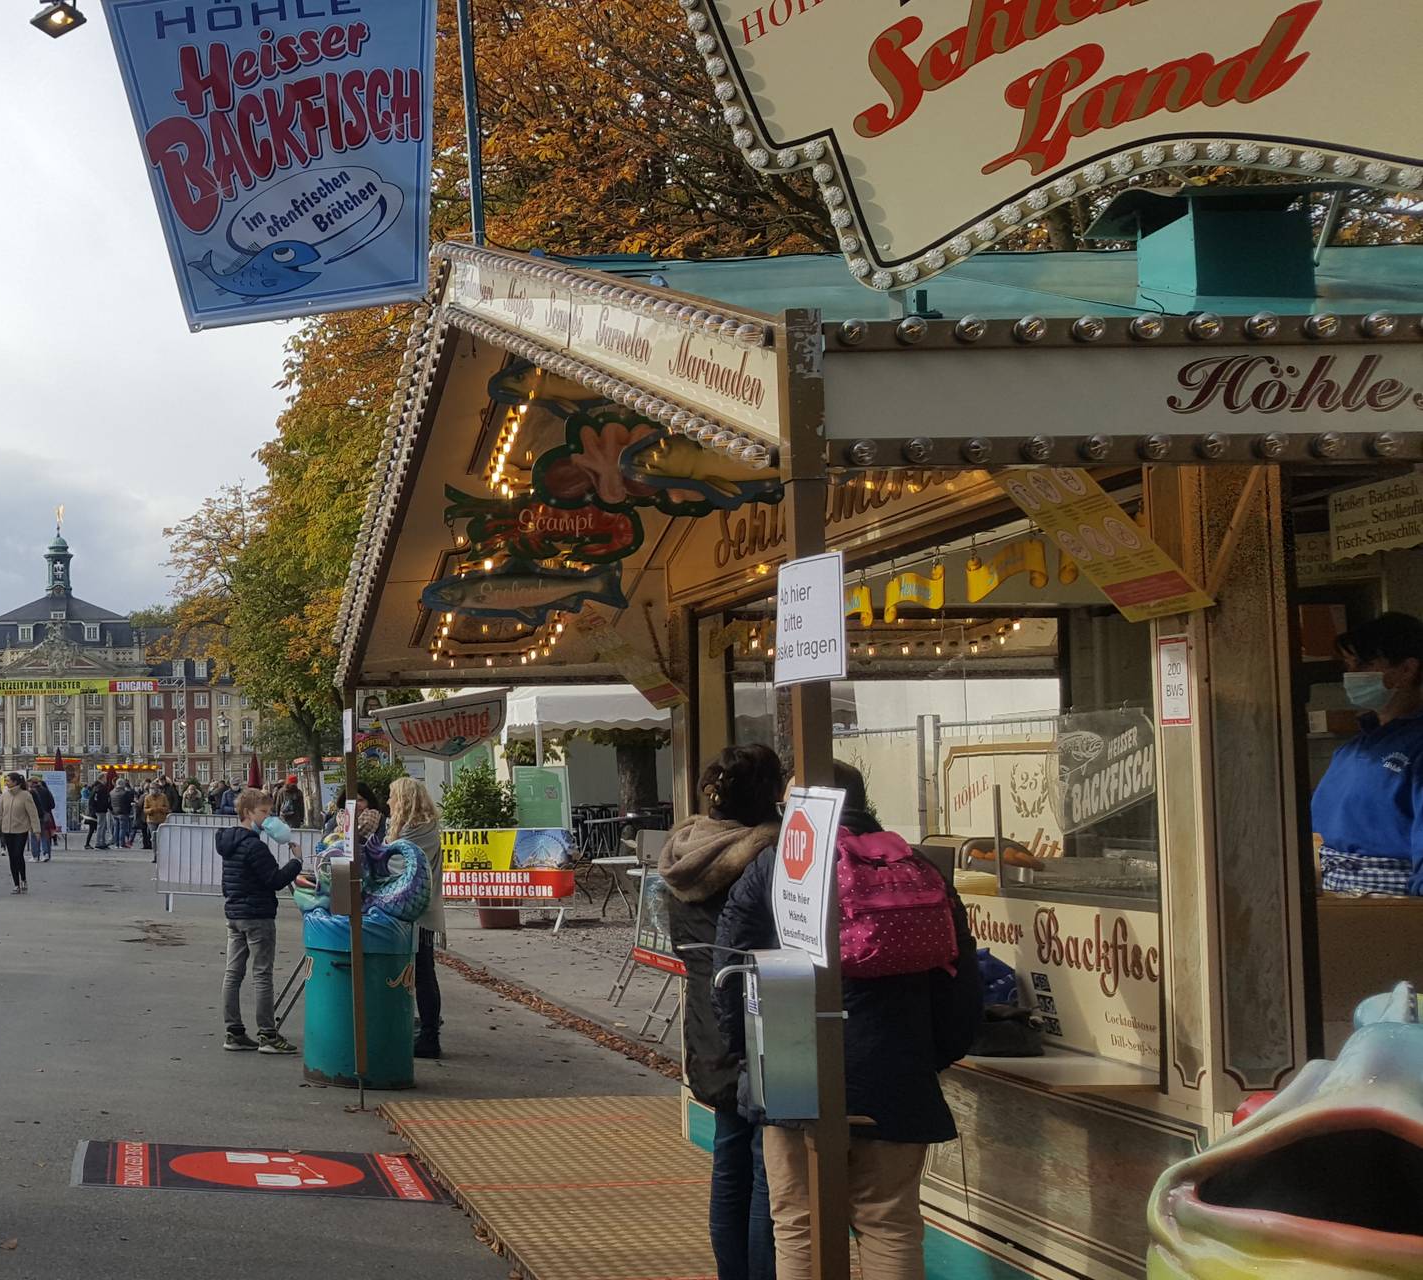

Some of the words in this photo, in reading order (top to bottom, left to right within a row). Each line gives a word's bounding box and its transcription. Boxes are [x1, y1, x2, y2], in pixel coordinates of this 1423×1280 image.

[173, 21, 370, 117] Heisser
[981, 0, 1323, 176] Land
[145, 66, 423, 233] BACKFISCH
[265, 168, 351, 238] ofenfrischen
[312, 180, 378, 234] Brötchen
[241, 211, 268, 233] im
[595, 307, 652, 366] Garnelen
[668, 331, 765, 410] Marinaden
[1166, 353, 1410, 416] Höhle
[1368, 480, 1420, 505] Backfisch
[518, 508, 595, 538] Scampi
[780, 587, 789, 606] Ab
[790, 584, 812, 602] hier
[783, 614, 803, 632] bitte
[777, 643, 794, 661] aske
[796, 637, 837, 660] tragen
[45, 680, 81, 690] MÜNSTER
[116, 680, 154, 692] EINGANG
[1166, 662, 1182, 676] 200
[399, 707, 490, 746] Kibbeling
[1107, 726, 1139, 761] HEISSER
[953, 774, 989, 812] HÖHLE
[1017, 771, 1040, 791] 25
[1071, 744, 1155, 824] BACKFISCH
[785, 829, 808, 862] STOP
[459, 871, 530, 884] REGISTRIEREN
[782, 889, 797, 903] Bitte
[797, 893, 810, 906] hier
[966, 903, 1024, 946] Heisser
